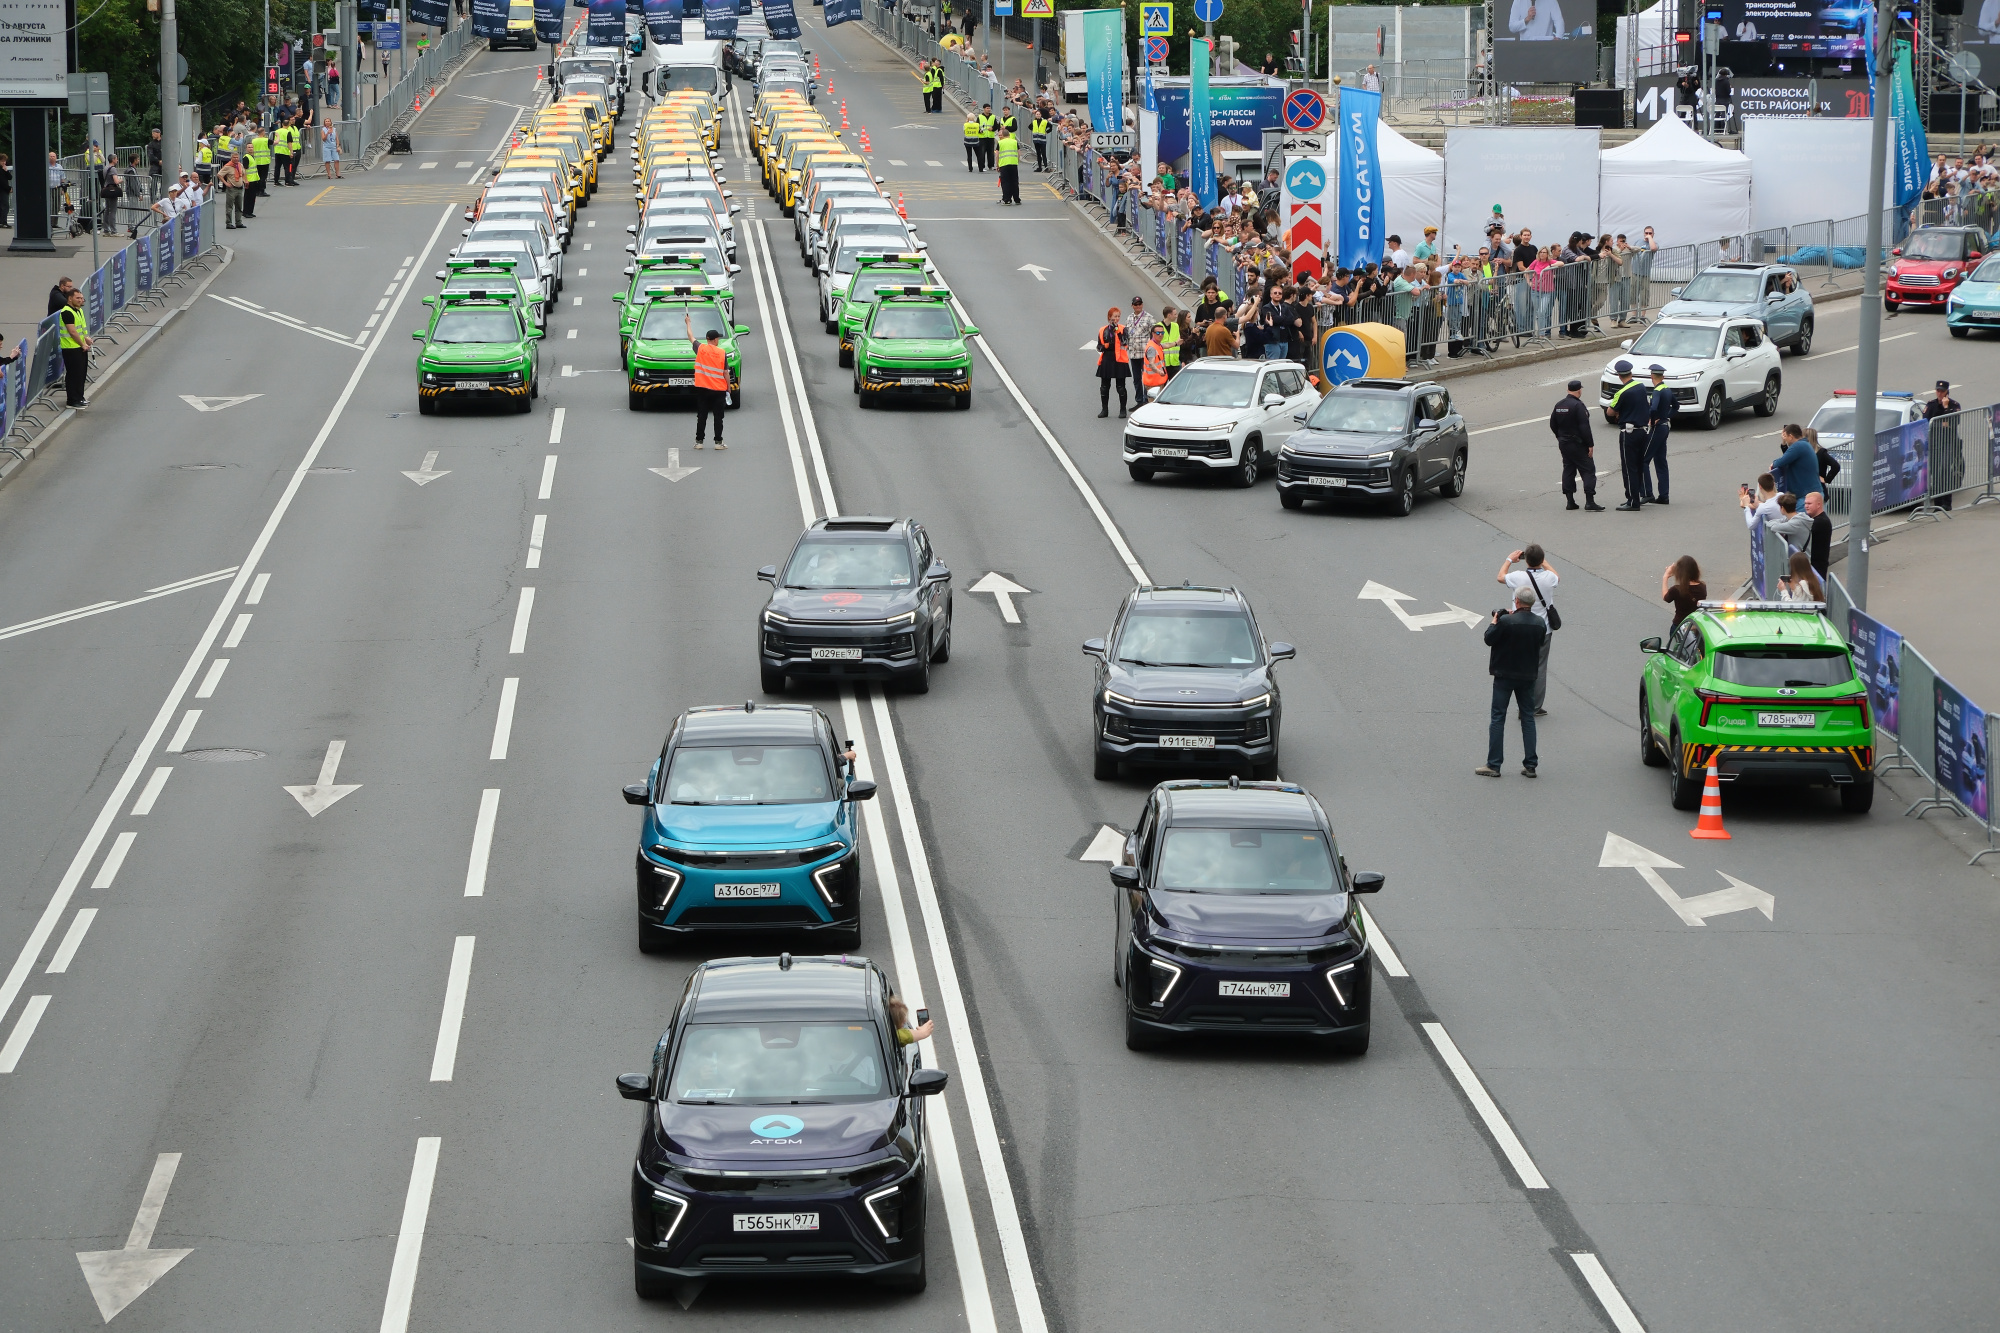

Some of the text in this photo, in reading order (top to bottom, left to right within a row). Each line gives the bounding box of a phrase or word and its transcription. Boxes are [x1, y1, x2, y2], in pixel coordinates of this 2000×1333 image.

[1745, 10, 1812, 18] электрофестиваль
[1741, 88, 1809, 97] МОСКОВСКА
[1740, 100, 1831, 110] СЕТЬ РАЙОНХ
[1228, 118, 1253, 126] Атом
[1097, 135, 1129, 145] СТОП
[1761, 715, 1797, 724] К785НК
[1162, 737, 1197, 746] У911ЕЕ
[718, 886, 759, 896] А316ОЕ
[1223, 983, 1287, 995] Т744НК 977
[738, 1214, 815, 1231] Т565НК 977
